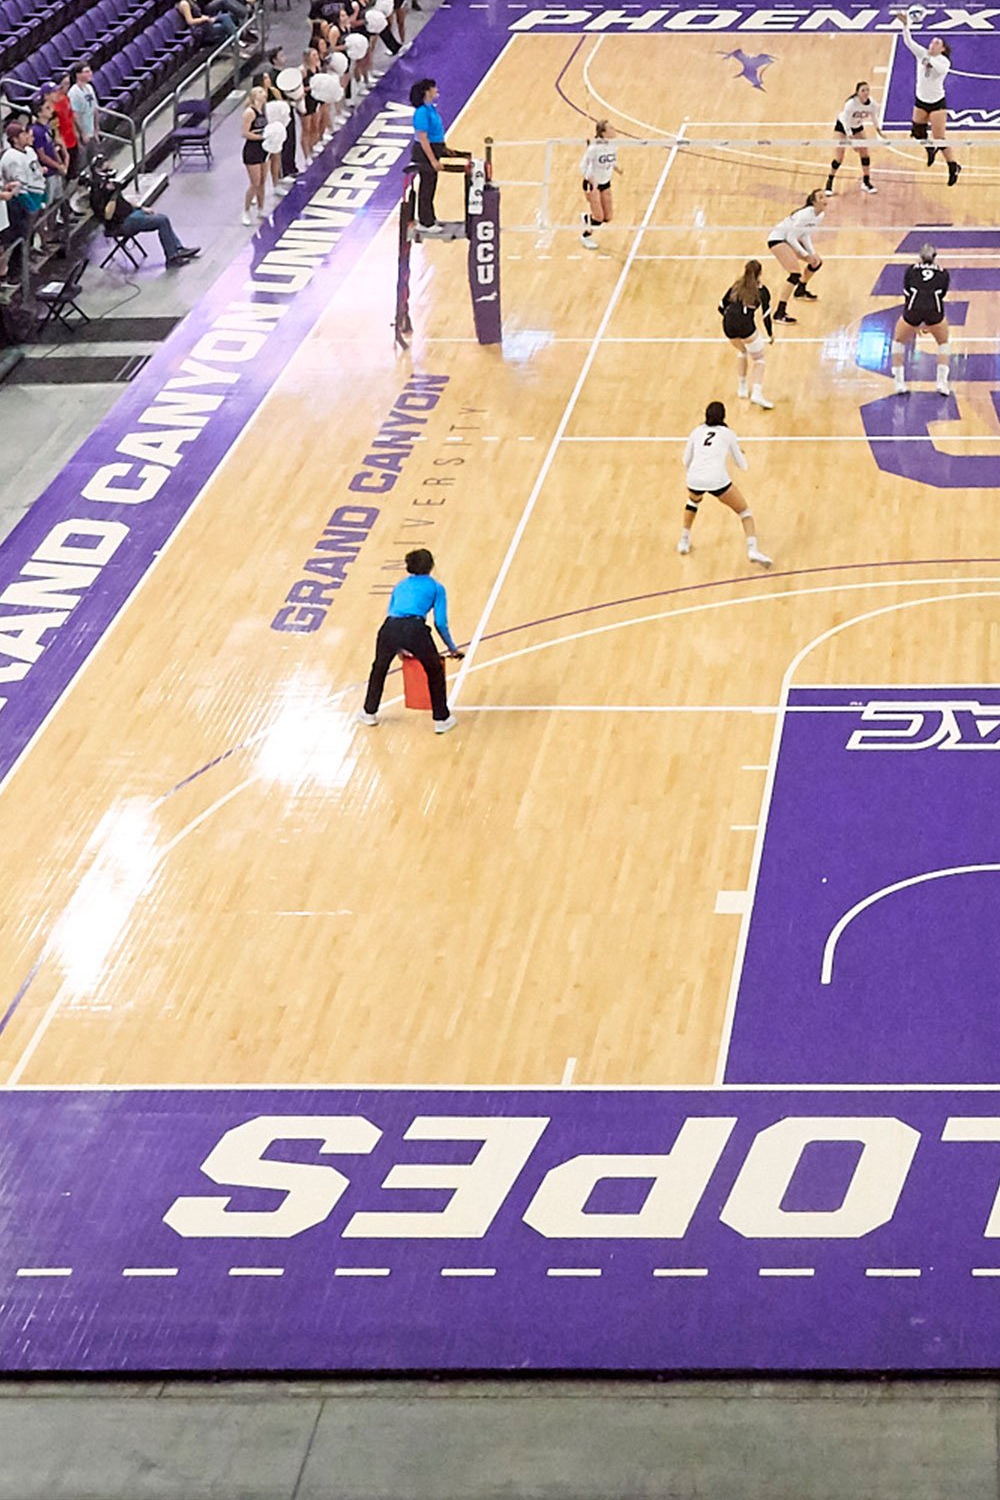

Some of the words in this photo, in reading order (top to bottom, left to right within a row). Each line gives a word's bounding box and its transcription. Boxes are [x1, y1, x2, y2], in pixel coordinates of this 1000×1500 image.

[476, 220, 495, 285] GCU
[921, 269, 935, 281] 9
[81, 301, 291, 505] CANYON
[242, 101, 415, 294] UNIVERSITY
[703, 431, 716, 447] 2
[270, 505, 380, 634] GRAND
[348, 373, 450, 494] CANYON
